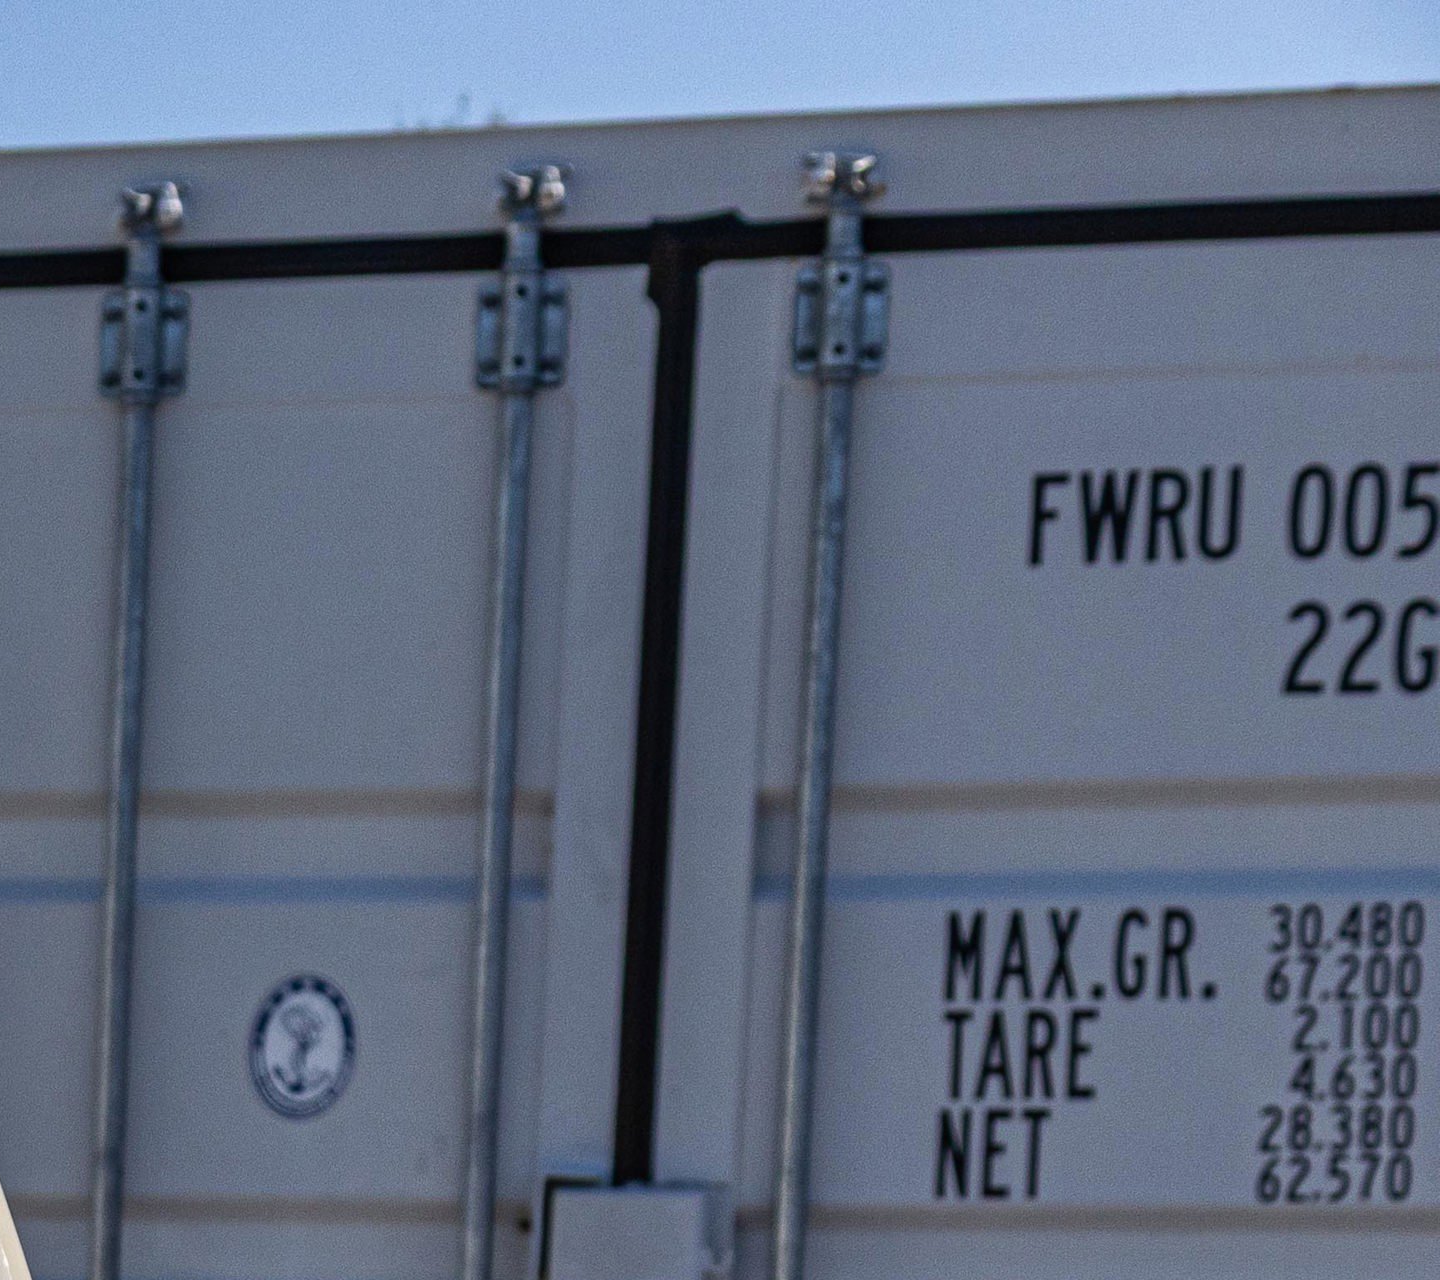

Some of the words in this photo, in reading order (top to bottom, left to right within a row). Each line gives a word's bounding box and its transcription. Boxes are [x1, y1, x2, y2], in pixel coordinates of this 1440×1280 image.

[1027, 464, 1244, 567] FWRU
[1288, 461, 1440, 562] 005
[1282, 598, 1440, 695] 22G
[943, 906, 1219, 1003] MAX.GR.
[1268, 902, 1426, 954] 30.480
[1265, 952, 1424, 1004] 67.200
[942, 1006, 1101, 1102] TARE
[1290, 1003, 1421, 1054] 2.100
[1289, 1053, 1418, 1102] 4.630
[934, 1106, 1051, 1201] NET
[1257, 1104, 1416, 1155] 28.380
[1255, 1152, 1414, 1204] 62.570
